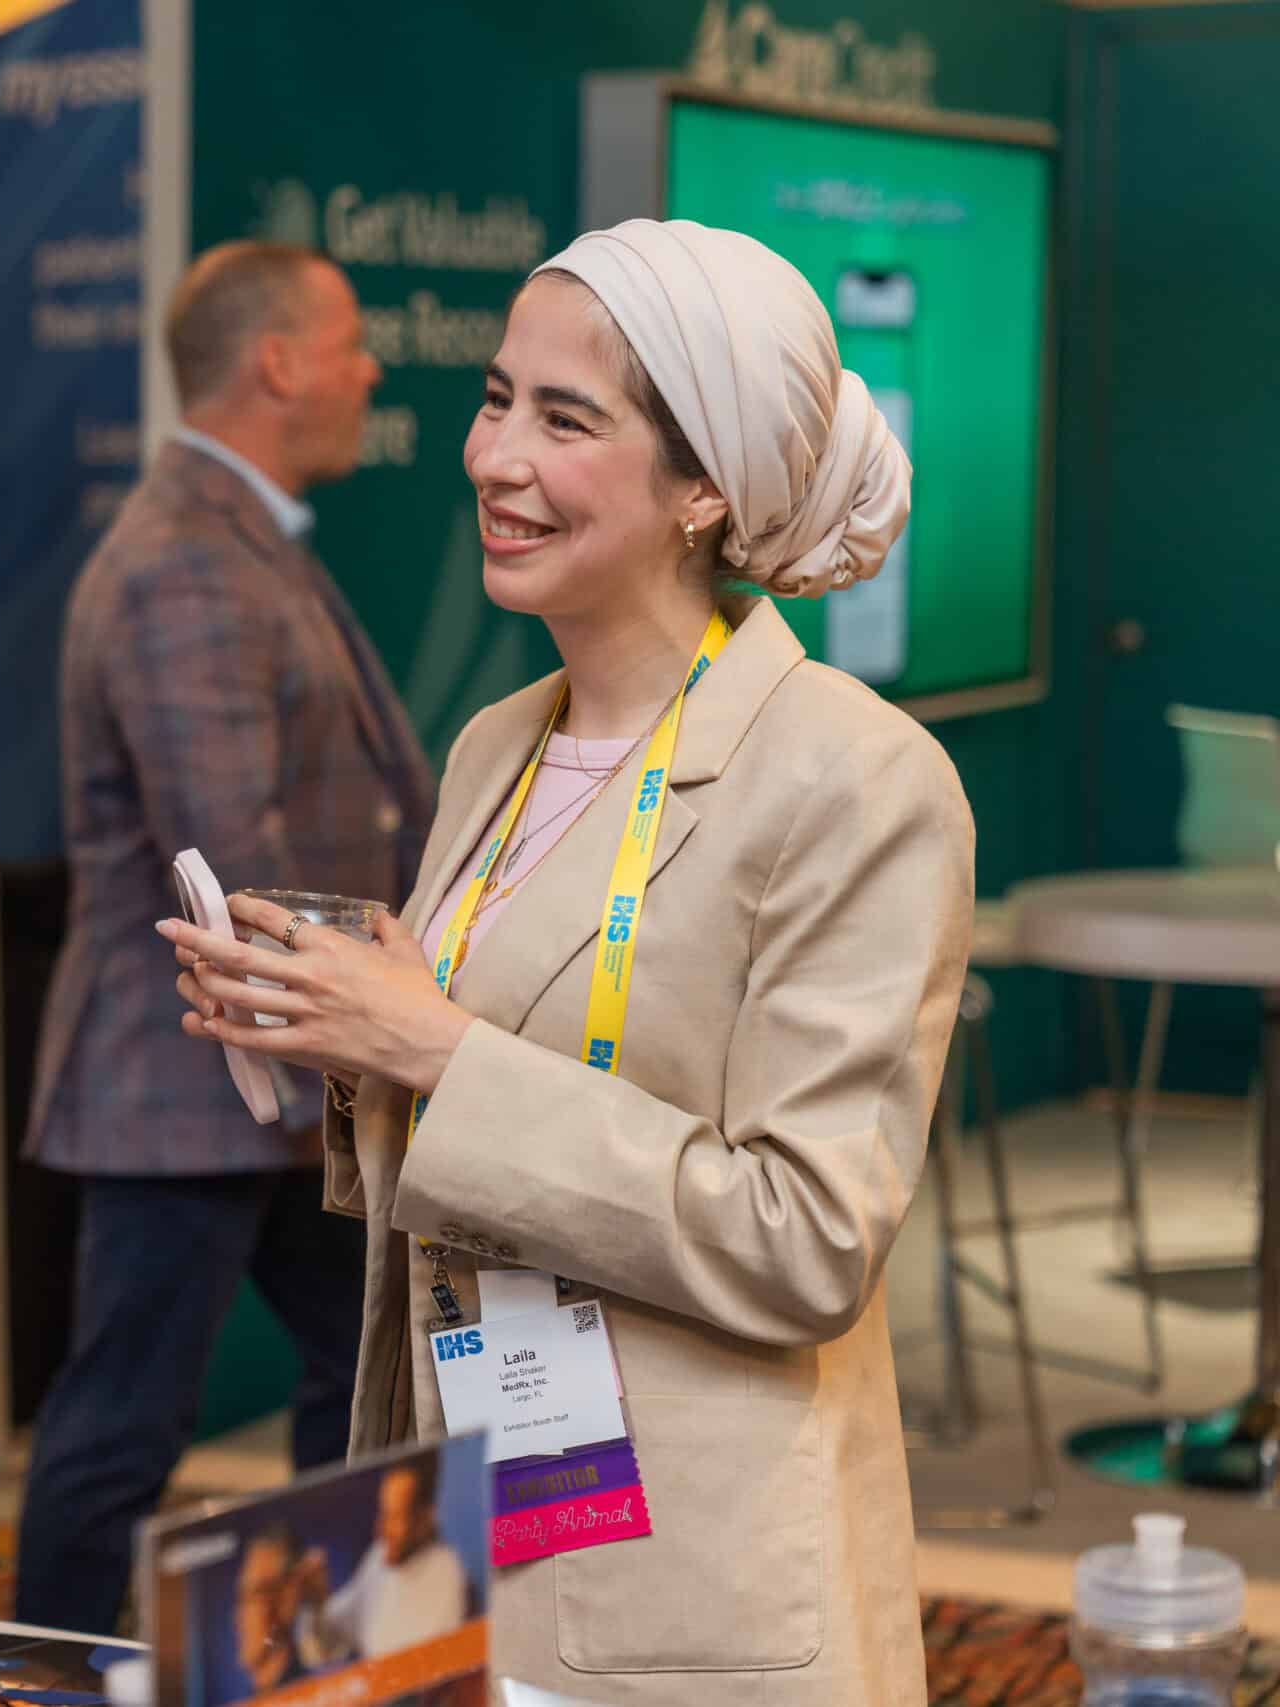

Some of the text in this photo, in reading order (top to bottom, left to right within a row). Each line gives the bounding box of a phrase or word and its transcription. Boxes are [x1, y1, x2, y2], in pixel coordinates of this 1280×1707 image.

[637, 767, 665, 812] IHS
[607, 894, 638, 942] IHS
[587, 1038, 615, 1072] IH
[434, 1329, 484, 1362] IHS
[503, 1349, 537, 1366] Laila
[498, 1370, 518, 1381] Laila
[554, 1498, 632, 1534] Animal
